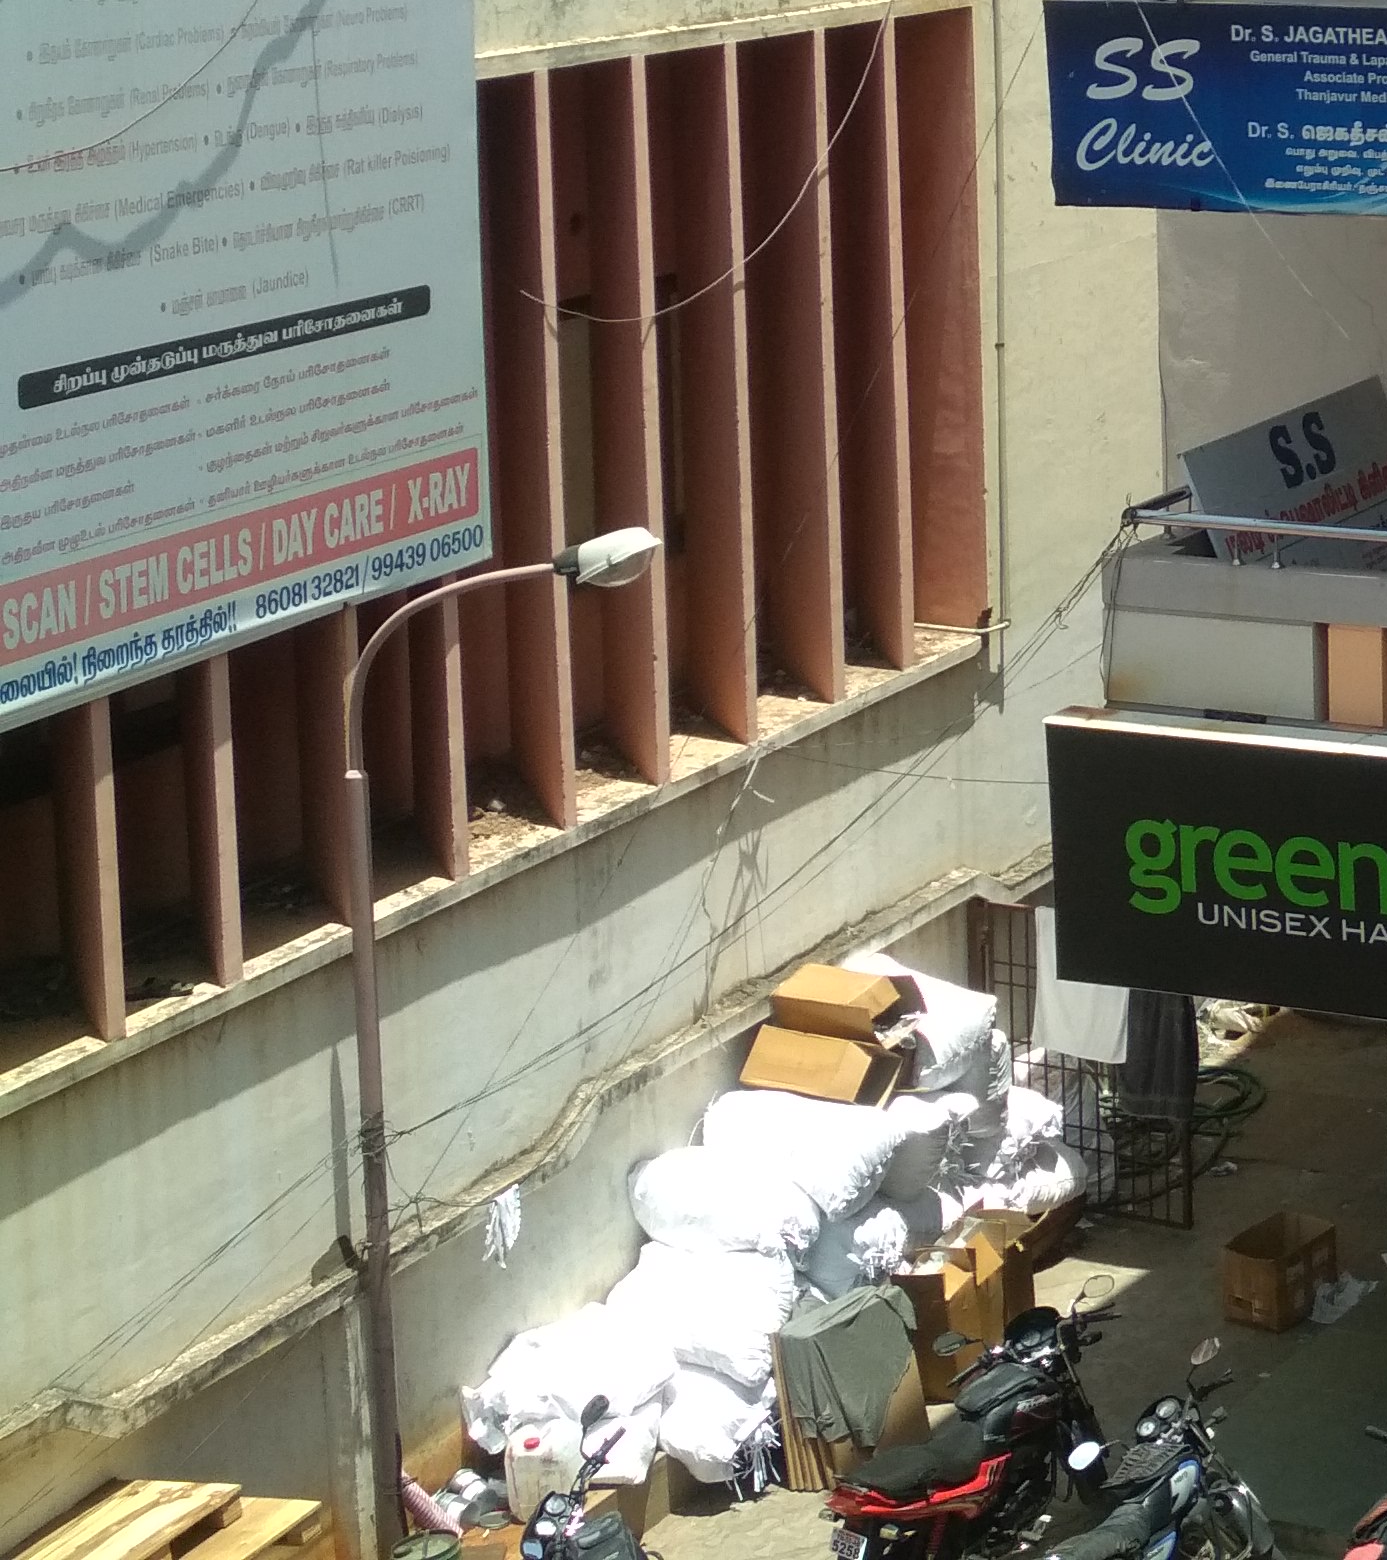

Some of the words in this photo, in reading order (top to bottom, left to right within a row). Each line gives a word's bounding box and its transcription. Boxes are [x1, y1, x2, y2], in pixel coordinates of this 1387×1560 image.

[1086, 37, 1200, 100] SS
[1250, 50, 1298, 63] General
[1301, 51, 1346, 66] Trauma
[1304, 70, 1365, 84] Associate
[1296, 88, 1358, 104] Thanjavur
[1076, 118, 1218, 171] Clinic
[53, 366, 107, 395] சிறப்பு
[1269, 412, 1336, 488] S.S
[2, 580, 76, 651] SCAN
[99, 555, 169, 620] STEM
[176, 530, 252, 605] CELLS
[272, 510, 317, 567] DAY
[323, 489, 383, 543] CARE
[407, 464, 470, 523] X-RAY
[255, 583, 308, 619] 86081
[430, 525, 484, 563] 06500
[1198, 902, 1331, 939] UNISEX
[832, 1540, 859, 1559] 5258
